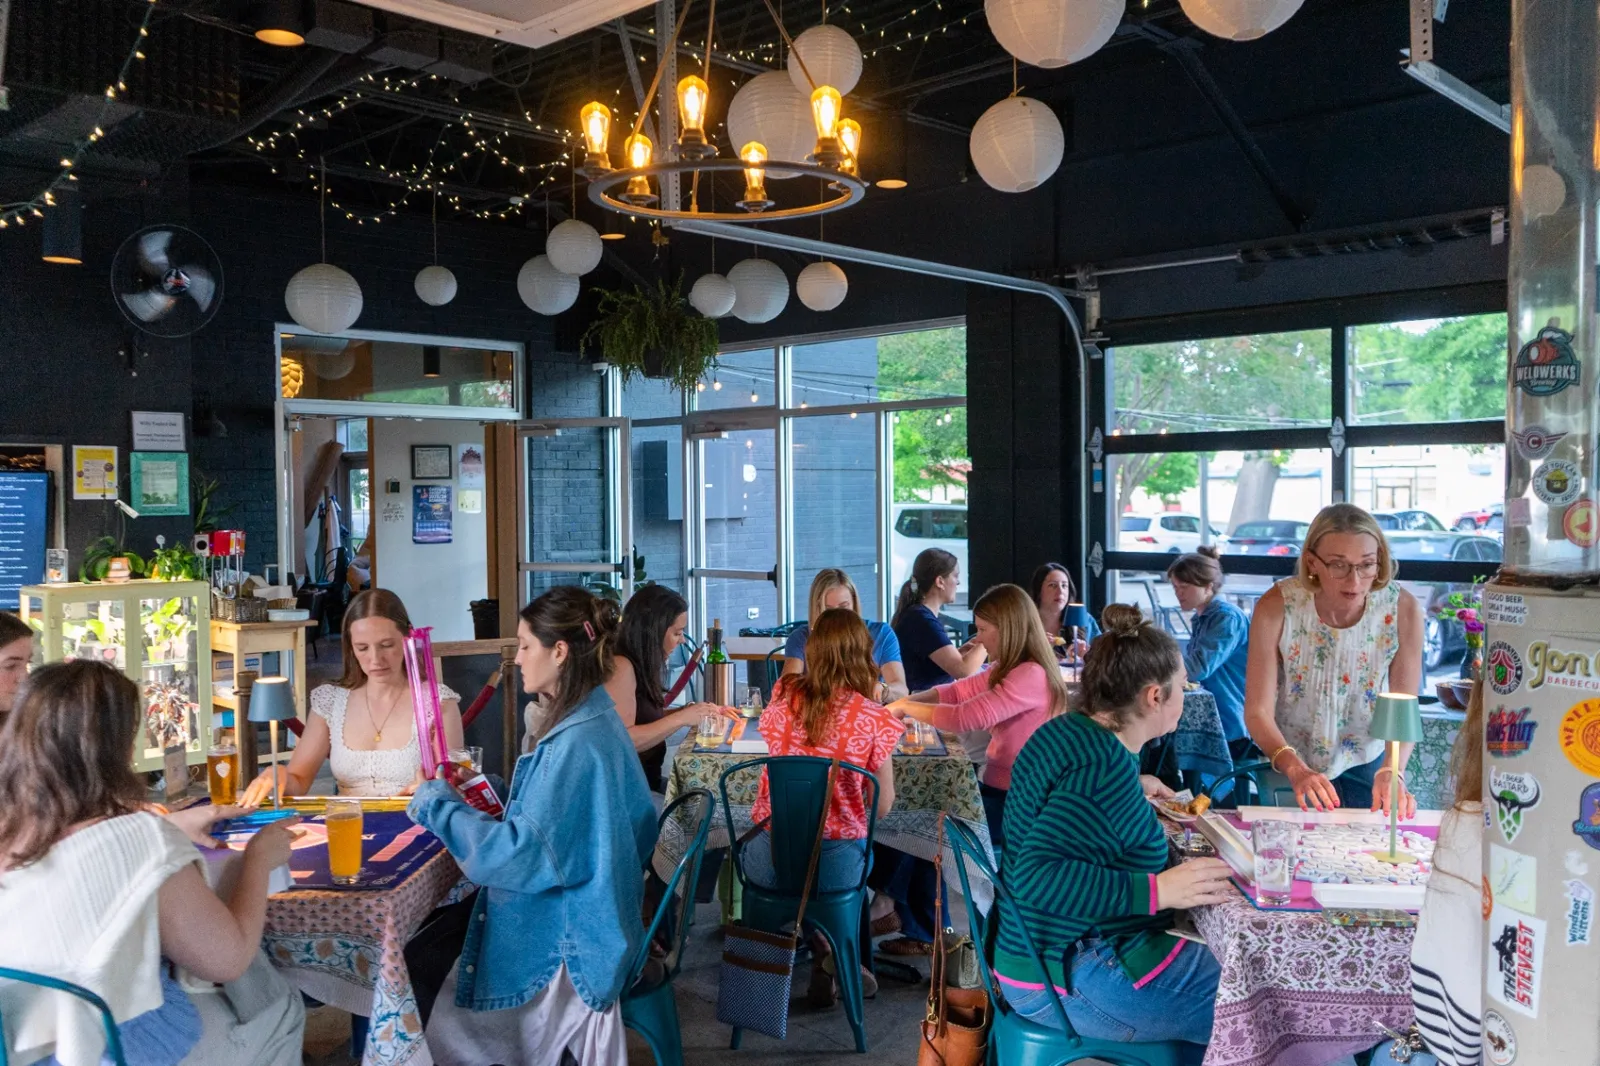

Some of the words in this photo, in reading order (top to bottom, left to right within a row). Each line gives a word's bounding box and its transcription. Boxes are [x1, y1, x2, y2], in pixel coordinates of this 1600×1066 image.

[1516, 365, 1576, 380] WELDWERKS
[1505, 595, 1523, 603] BEER
[1488, 612, 1498, 620] BEST
[1504, 605, 1527, 614] MUSIC
[1547, 676, 1600, 690] BARBECU
[1568, 898, 1581, 943] Windsor
[1516, 919, 1535, 1009] STEVEST
[1503, 963, 1516, 1002] THE
